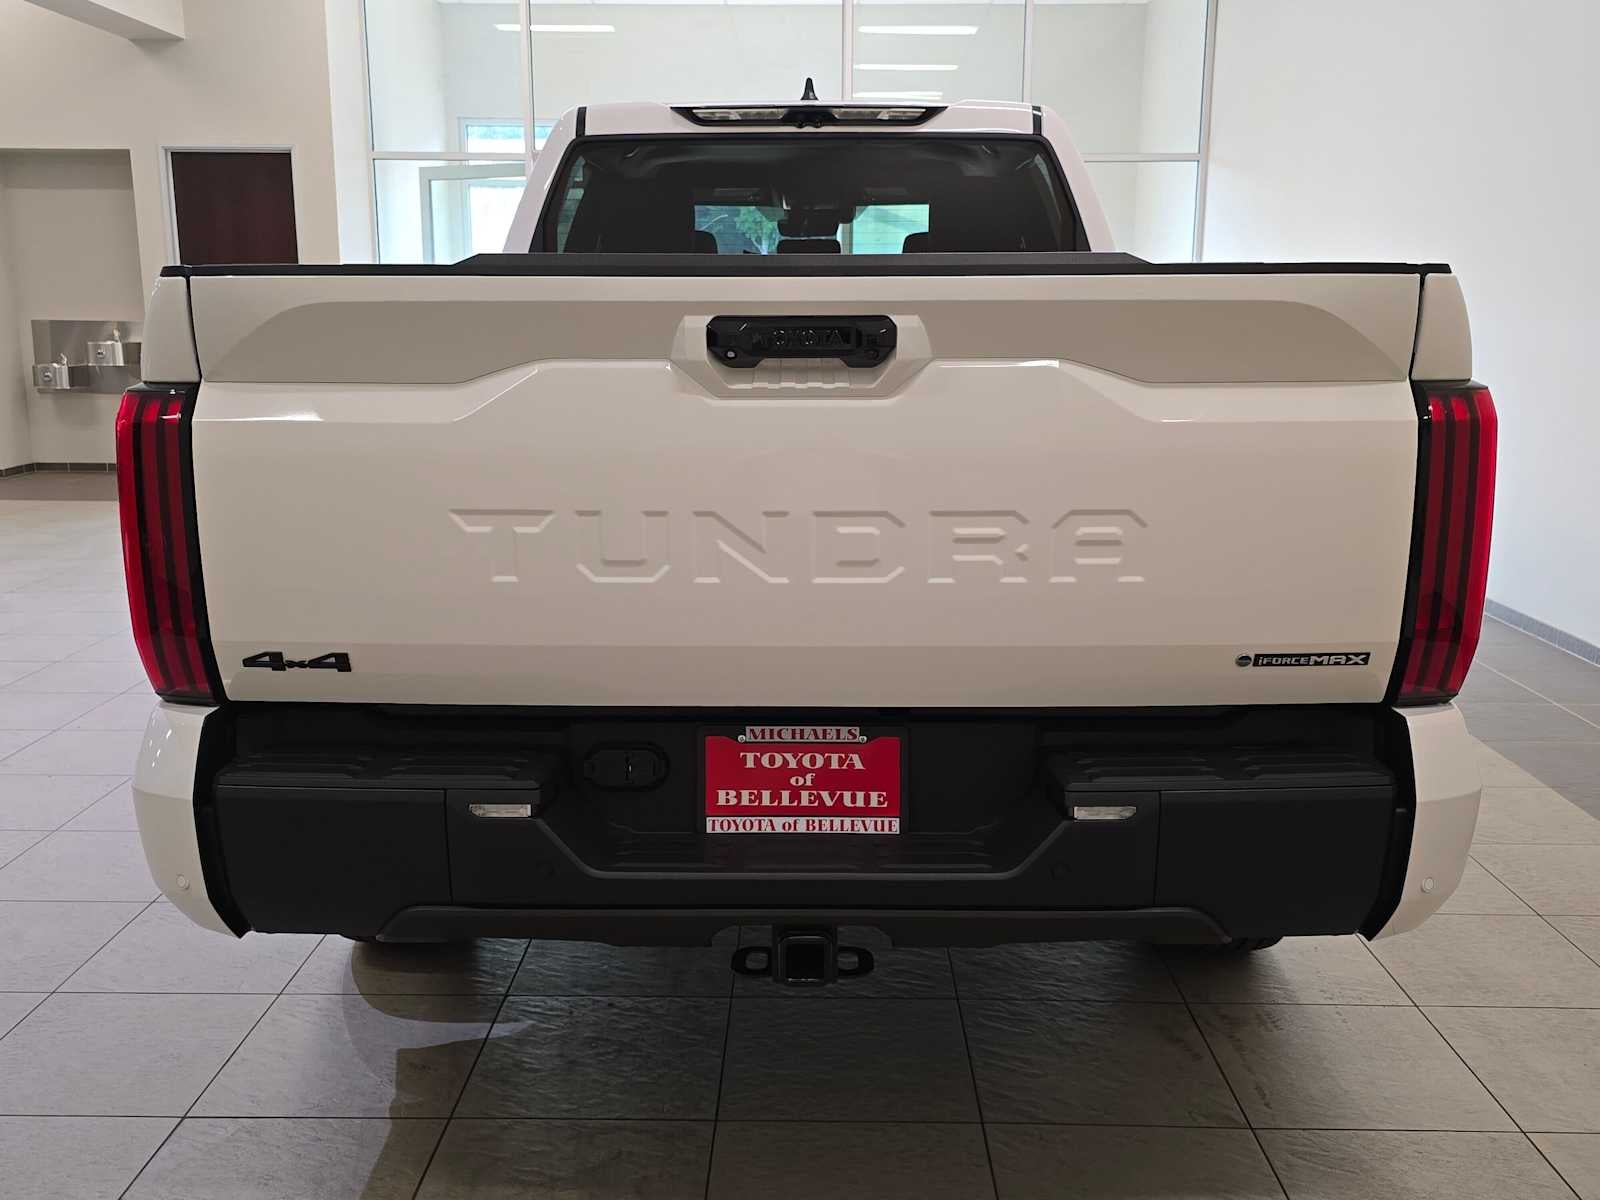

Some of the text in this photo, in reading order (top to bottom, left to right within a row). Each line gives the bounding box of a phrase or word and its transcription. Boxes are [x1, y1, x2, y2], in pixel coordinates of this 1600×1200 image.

[450, 509, 1149, 584] TUNDRA
[749, 728, 859, 740] MICHAELS
[740, 752, 865, 769] TOYOTA
[790, 773, 816, 786] of
[716, 790, 888, 807] BELLEVUE
[708, 819, 898, 832] TOYOTA of BELLEVUE
